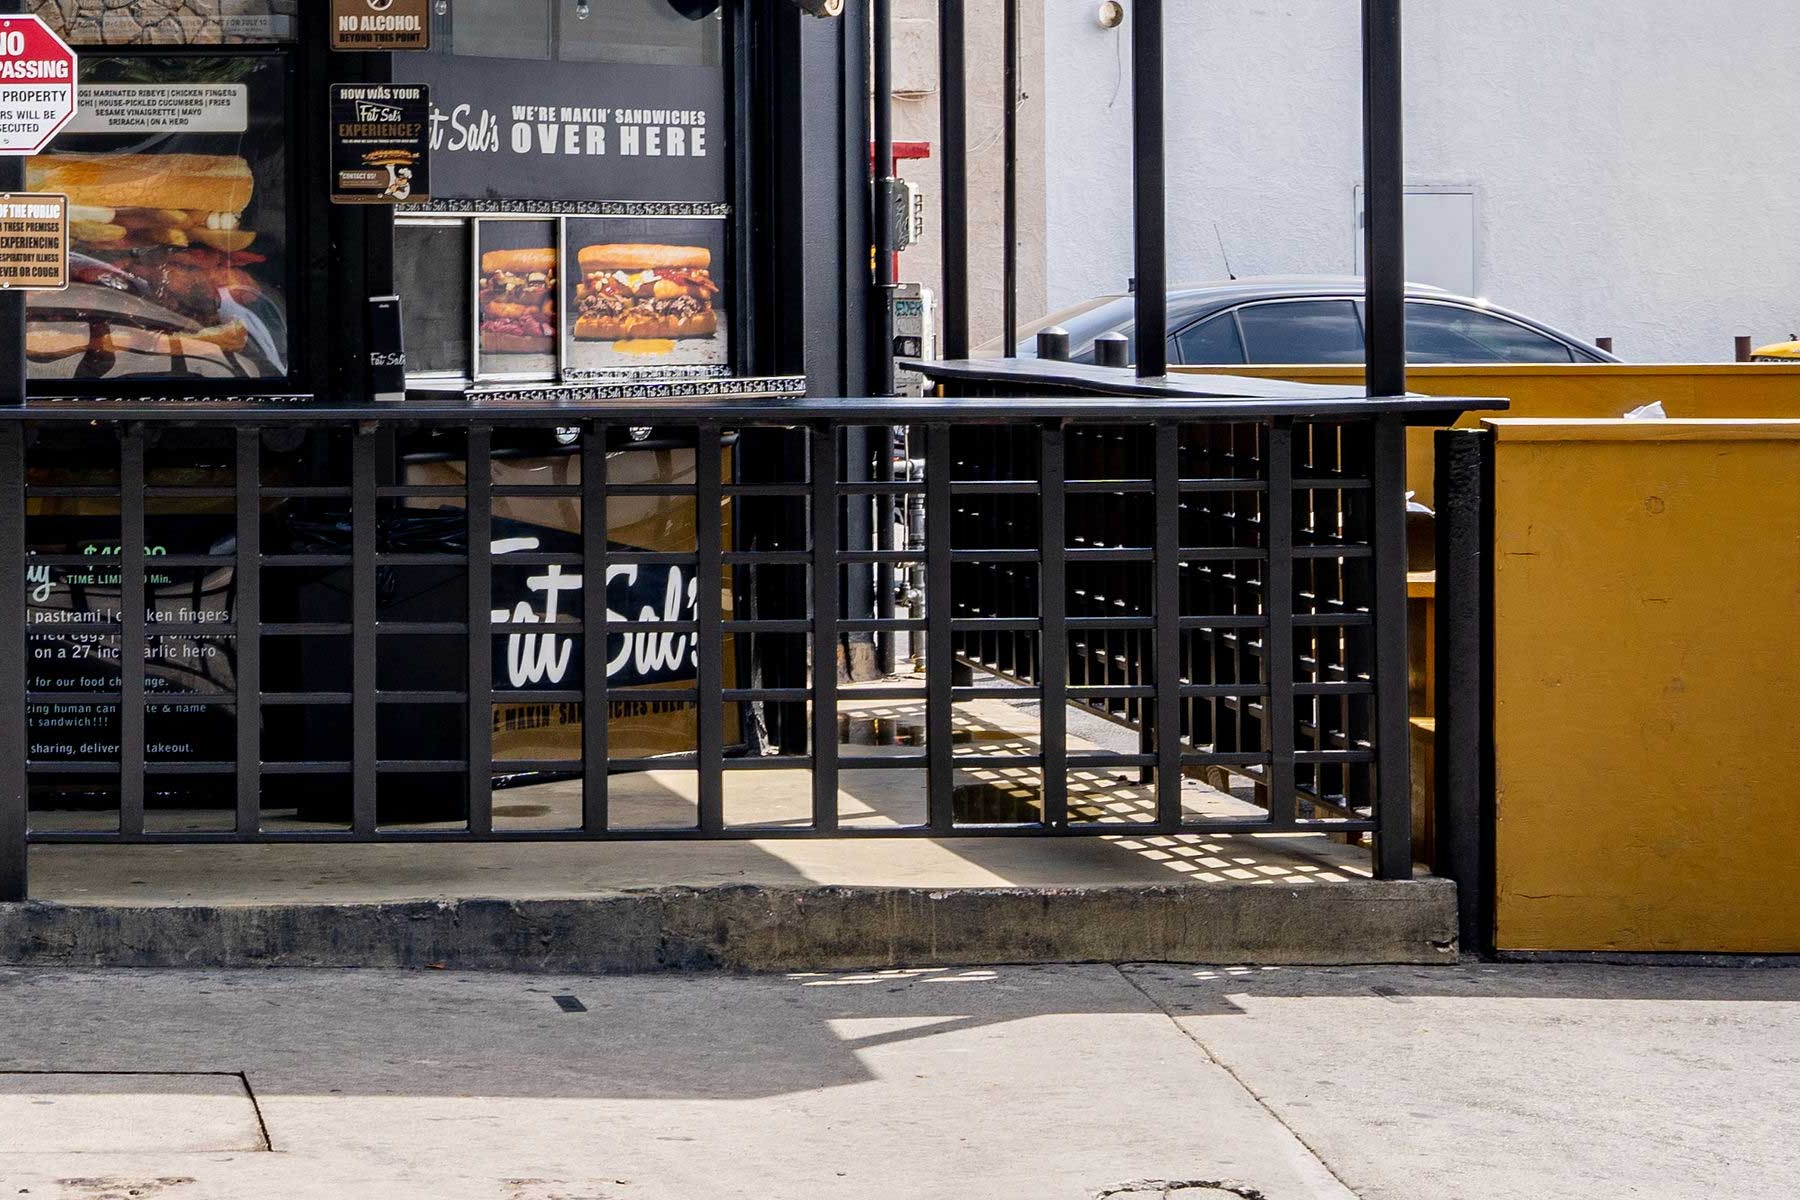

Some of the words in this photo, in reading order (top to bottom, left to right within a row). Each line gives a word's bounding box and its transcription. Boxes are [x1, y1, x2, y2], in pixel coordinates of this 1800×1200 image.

[339, 15, 358, 31] NO
[360, 15, 421, 31] ALCOHOL
[340, 33, 372, 42] BEYOND
[374, 33, 394, 42] THIS
[396, 33, 420, 42] POINT
[3, 90, 67, 102] PROPERTY
[205, 89, 237, 97] FINGERS
[340, 89, 365, 99] HOW
[367, 88, 391, 99] WAS
[392, 88, 420, 99] YOUR
[98, 99, 157, 107] HOUSE-PICKLED
[158, 99, 203, 107] CUCUMBERS
[17, 111, 40, 119] WILL
[44, 110, 56, 119] BE
[360, 105, 381, 121] Fat
[381, 108, 401, 121] Sal's
[512, 105, 556, 121] WE'RE
[561, 107, 611, 123] MAKIN'
[615, 109, 706, 125] SANDWICHES
[339, 123, 421, 137] EXPERIENCE?
[448, 104, 499, 152] Sal's
[511, 122, 605, 155] OVER
[620, 125, 706, 156] HERE
[9, 204, 26, 218] THE
[28, 204, 60, 218] PUBLIC
[4, 222, 24, 232] THESE
[26, 222, 59, 232] PREMISES
[0, 237, 59, 249] EXPERIENCING
[32, 267, 59, 277] COUGH
[66, 575, 95, 584] TIME
[35, 609, 101, 625] pastrami
[179, 608, 229, 624] fingers
[34, 649, 52, 659] on
[72, 645, 90, 659] 27
[182, 644, 216, 658] hero
[80, 676, 105, 687] food
[54, 703, 92, 713] human
[38, 717, 109, 728] sandwich!!!
[31, 744, 77, 755] sharing,
[146, 744, 194, 754] takeout.
